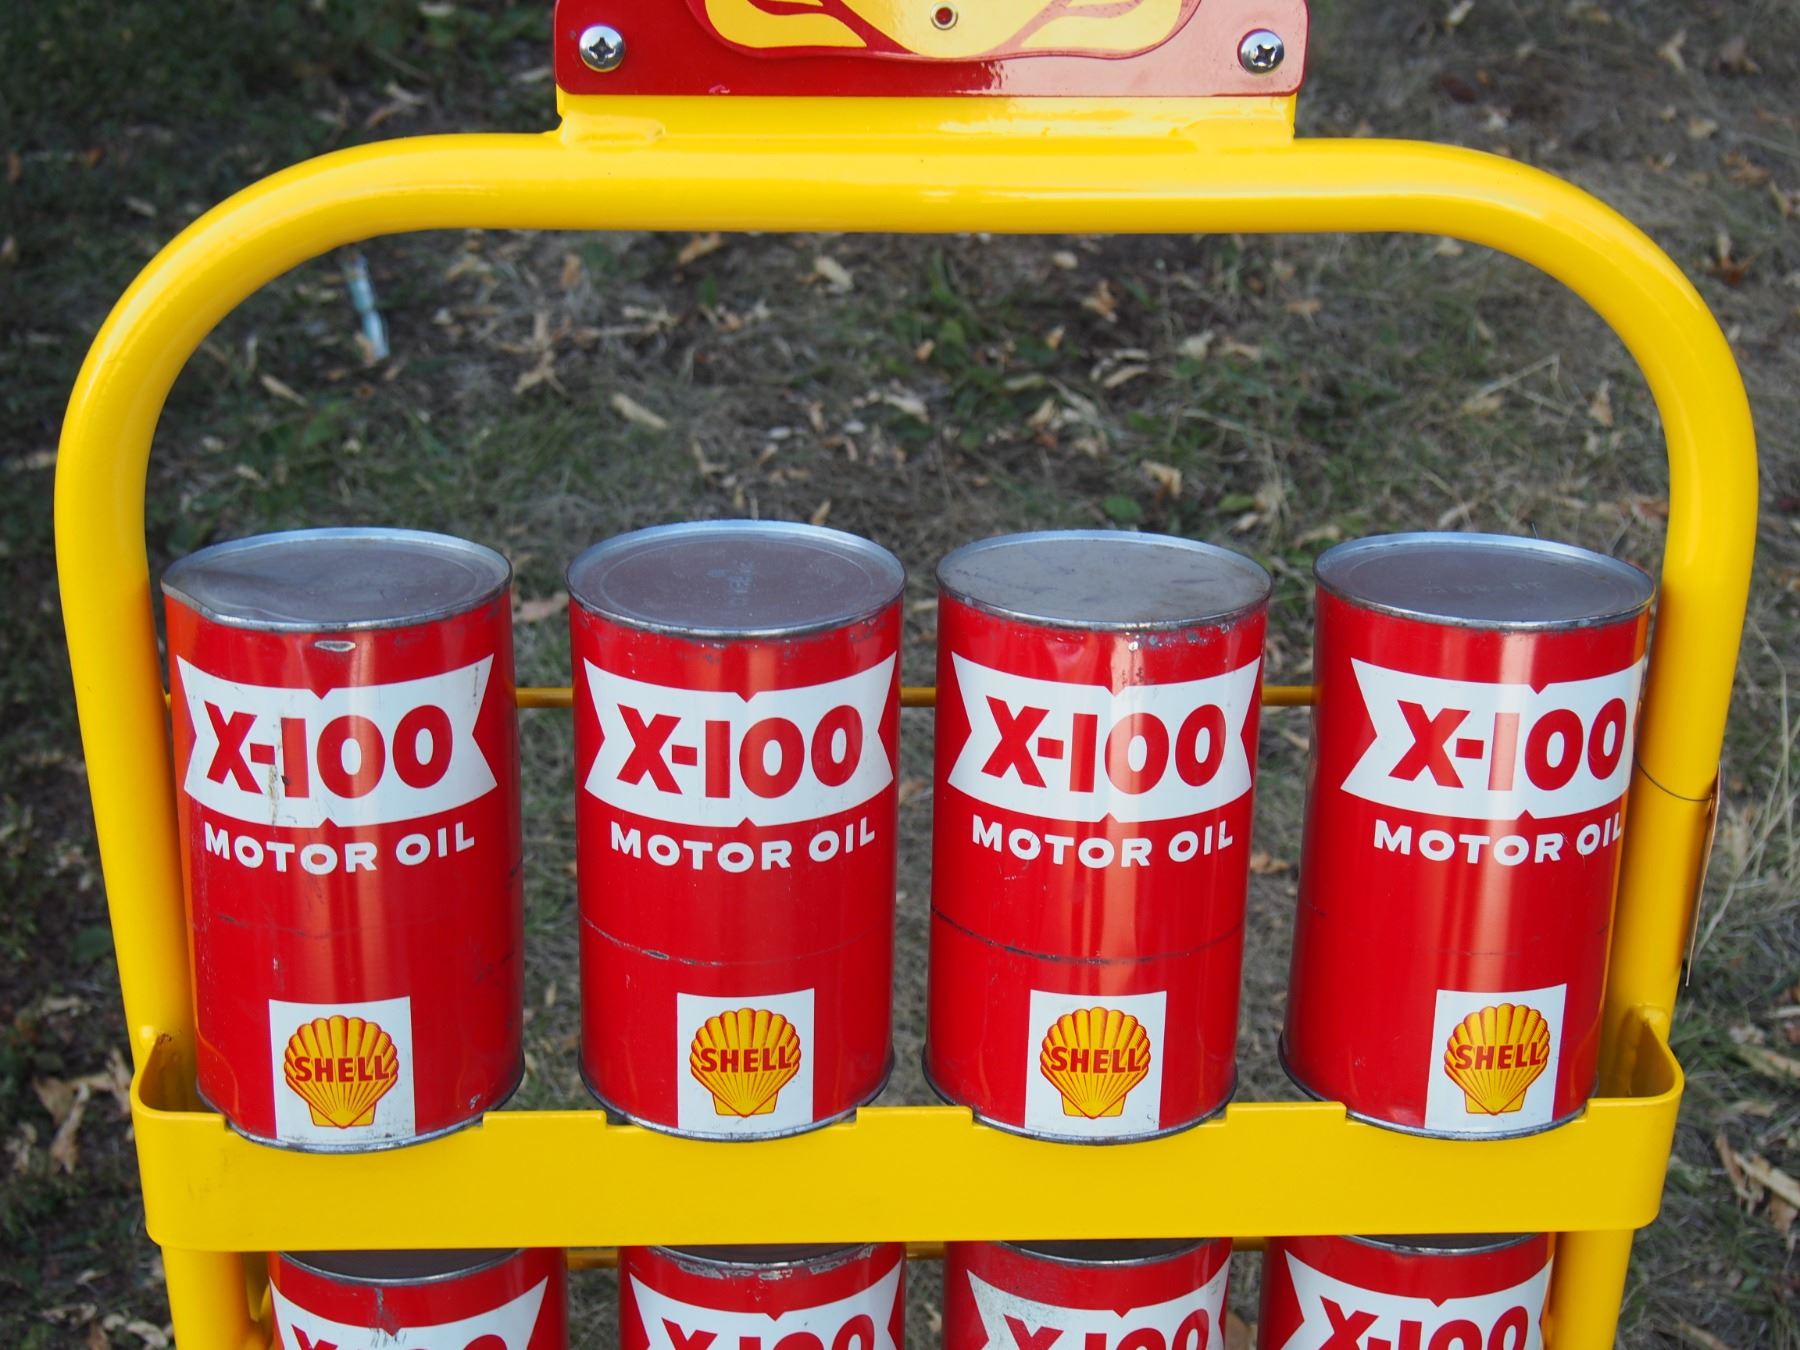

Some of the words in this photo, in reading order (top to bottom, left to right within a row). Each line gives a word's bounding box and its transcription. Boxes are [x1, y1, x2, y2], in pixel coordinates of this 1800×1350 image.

[204, 700, 453, 799] X-100
[616, 703, 864, 799] X-100
[981, 695, 1227, 795] X-100
[1388, 698, 1627, 791] X-100
[204, 821, 378, 875] MOTOR
[395, 821, 475, 866] OIL
[611, 820, 793, 873] MOTOR
[808, 816, 875, 862] OIL
[972, 814, 1153, 868] MOTOR
[1168, 820, 1233, 862] OIL
[1373, 819, 1564, 866] MOTOR
[1576, 812, 1621, 856] OIL
[294, 1055, 390, 1083] SHELL
[700, 1045, 792, 1073] SHELL
[1050, 1046, 1141, 1074] SHELL
[1454, 1041, 1542, 1070] SHELL
